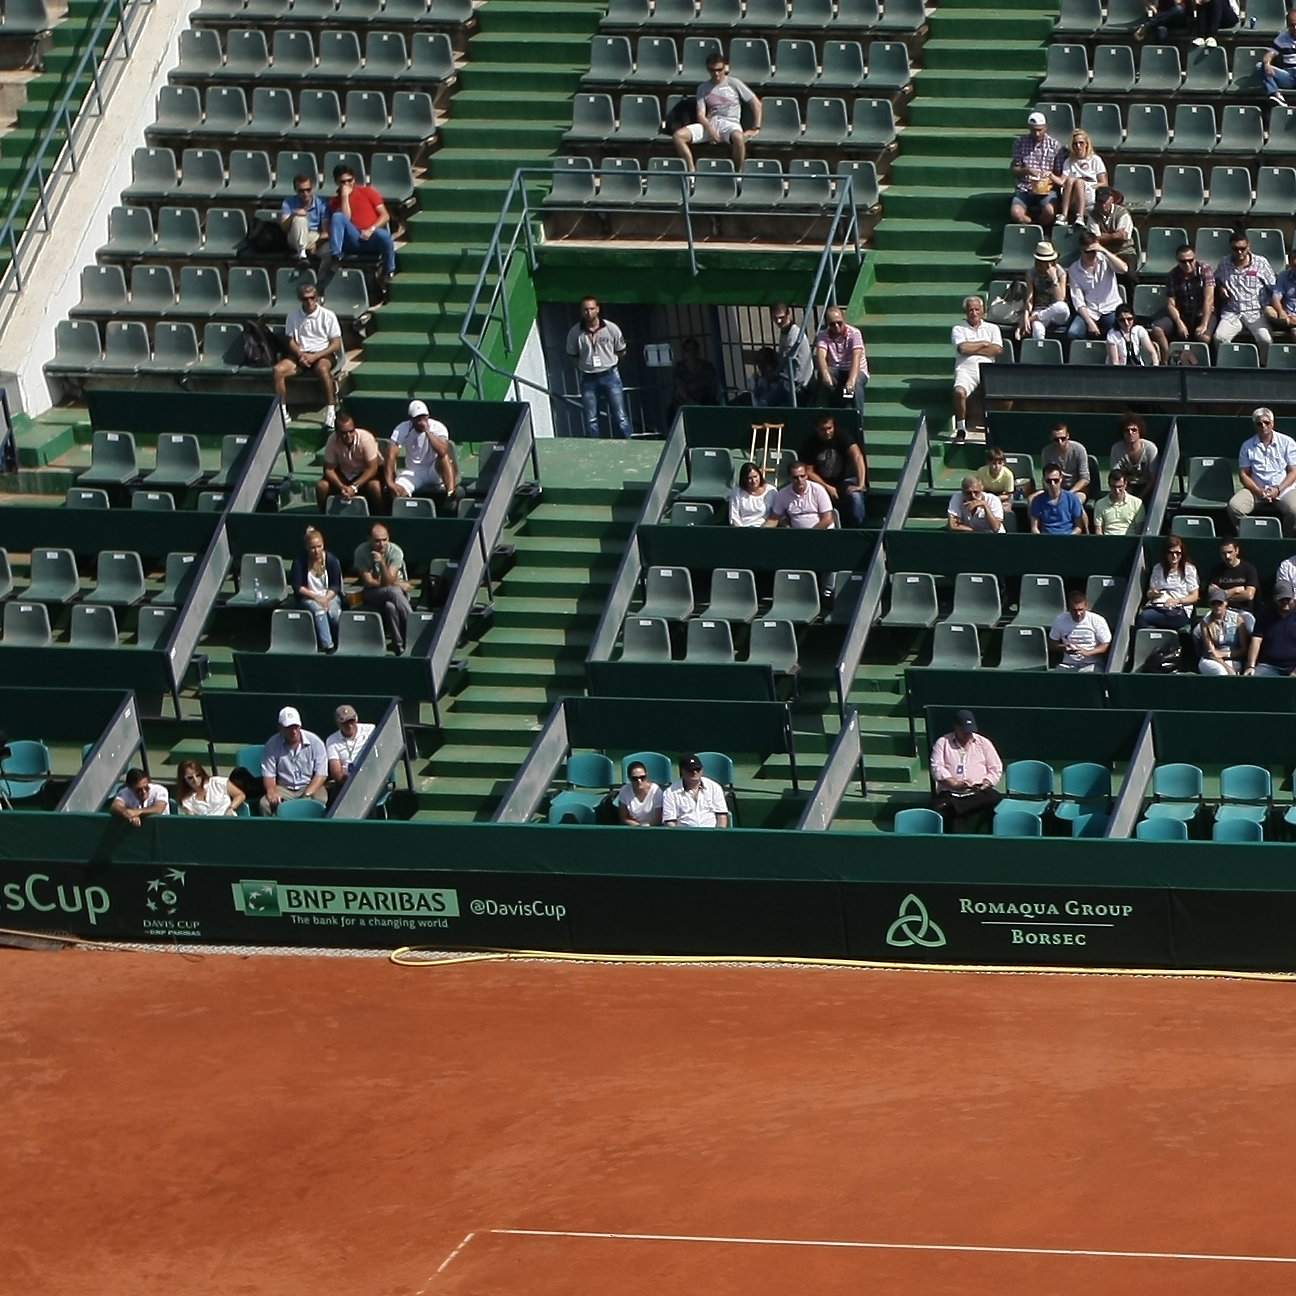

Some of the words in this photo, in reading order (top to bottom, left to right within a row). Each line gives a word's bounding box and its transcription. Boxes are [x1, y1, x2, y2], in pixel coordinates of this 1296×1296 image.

[0, 873, 110, 925] sCup
[286, 889, 336, 910] BNP
[343, 890, 446, 912] PARIBAS
[470, 899, 567, 921] @DavisCup
[143, 919, 175, 929] DAVIS
[177, 920, 200, 929] CUP
[290, 914, 310, 925] The
[313, 915, 338, 926] bank
[341, 916, 355, 928] for
[368, 917, 416, 929] changing
[418, 918, 449, 928] world
